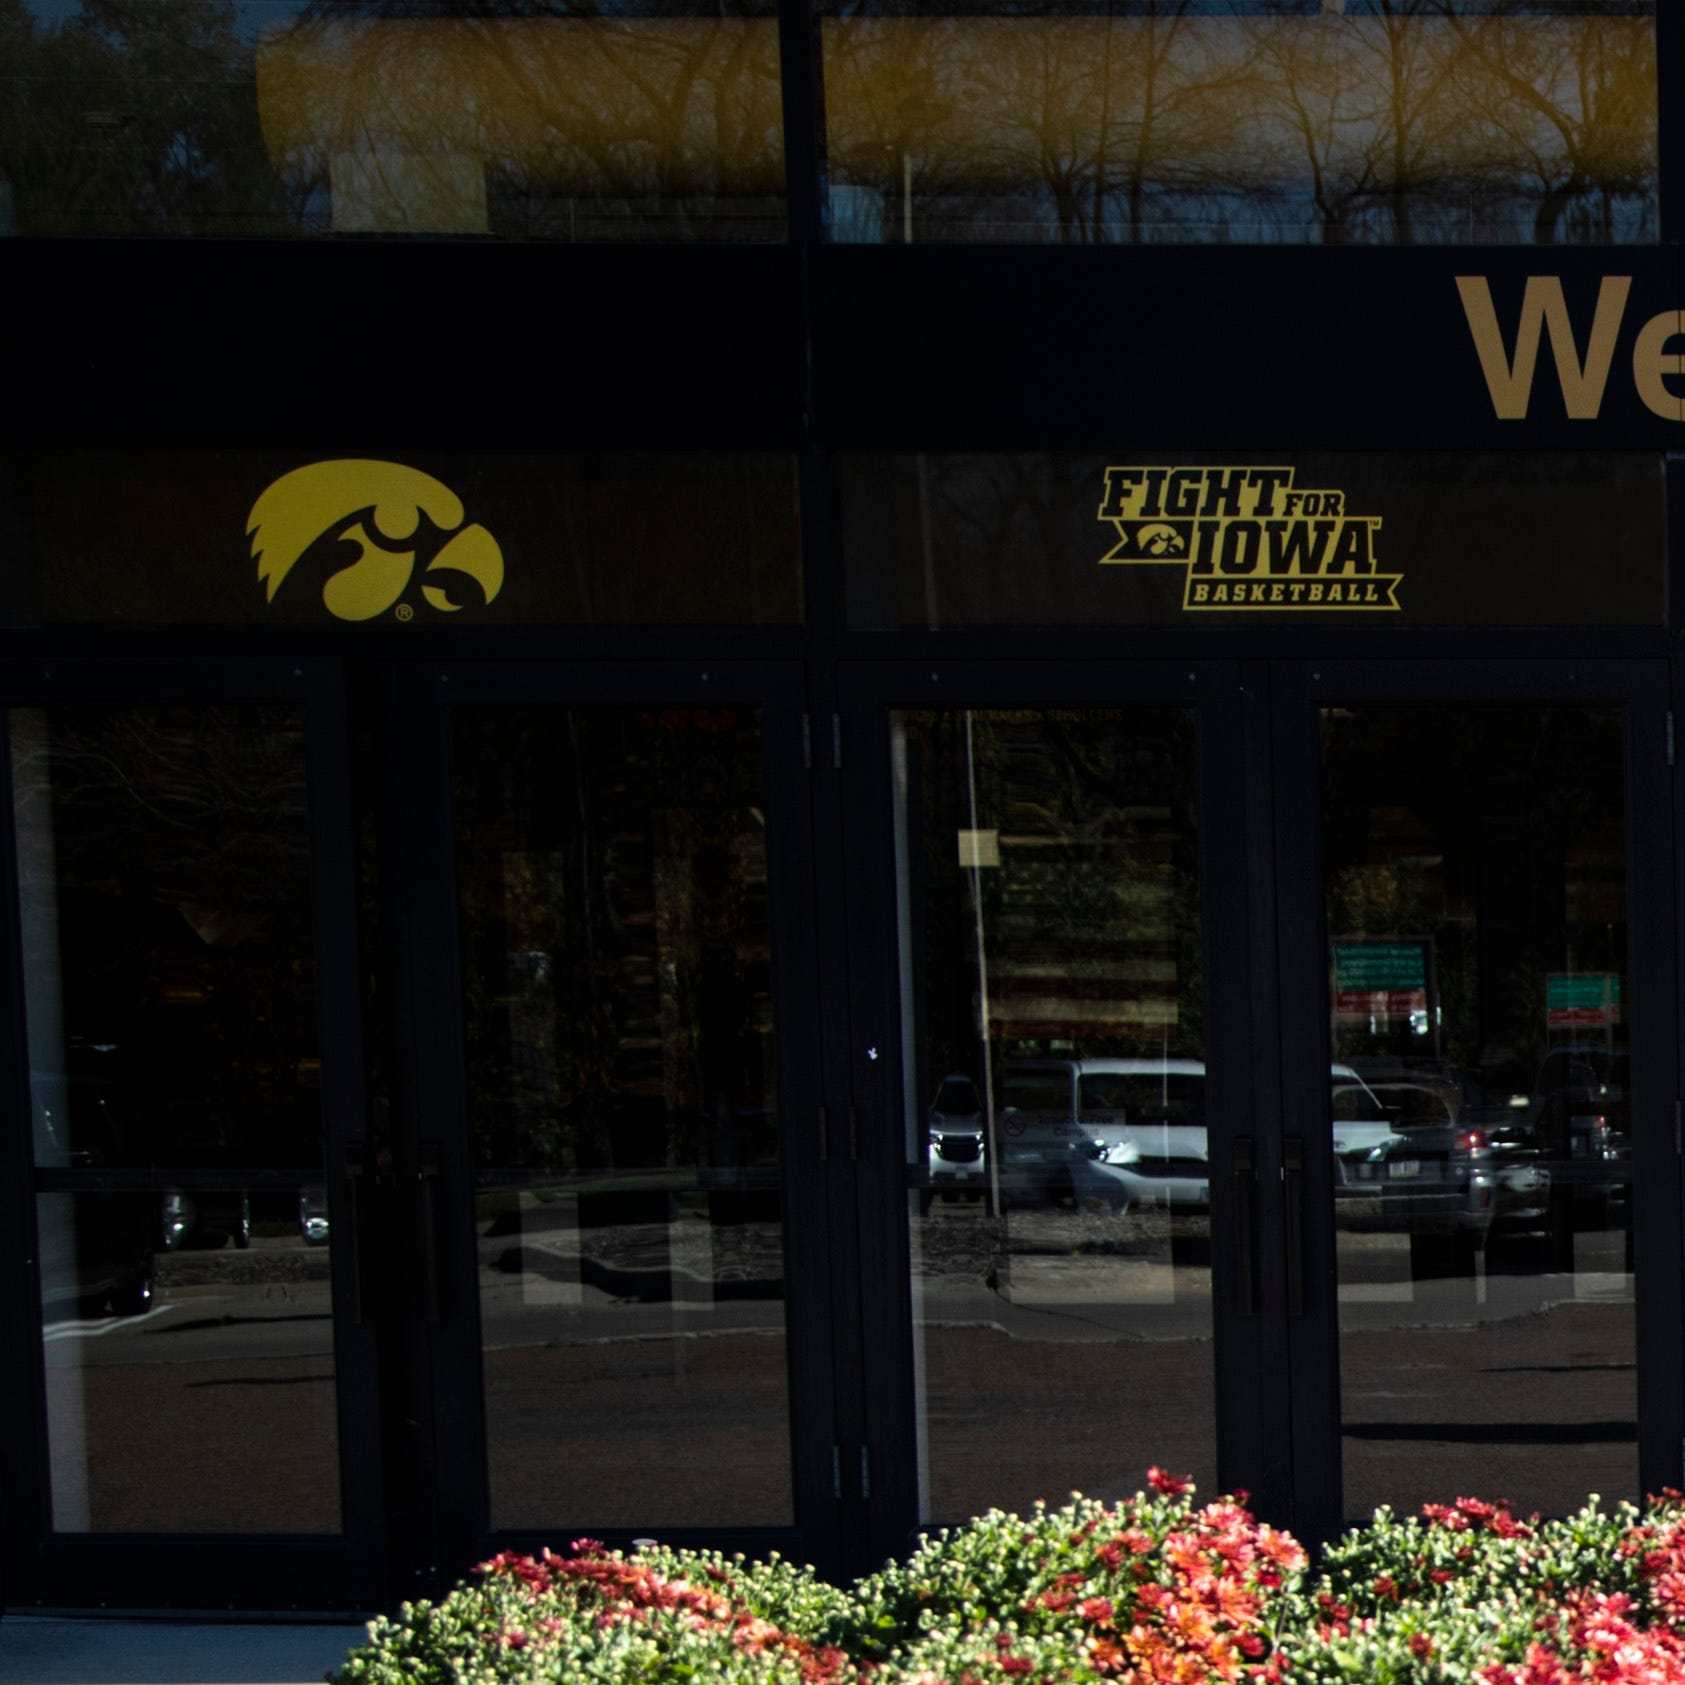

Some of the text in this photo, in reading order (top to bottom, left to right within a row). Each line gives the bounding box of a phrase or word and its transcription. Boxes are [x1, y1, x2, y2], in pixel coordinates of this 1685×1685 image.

[1102, 469, 1341, 517] FIGHT FOR
[1192, 520, 1373, 575] IOWA
[1194, 583, 1378, 603] BASKETBALL
